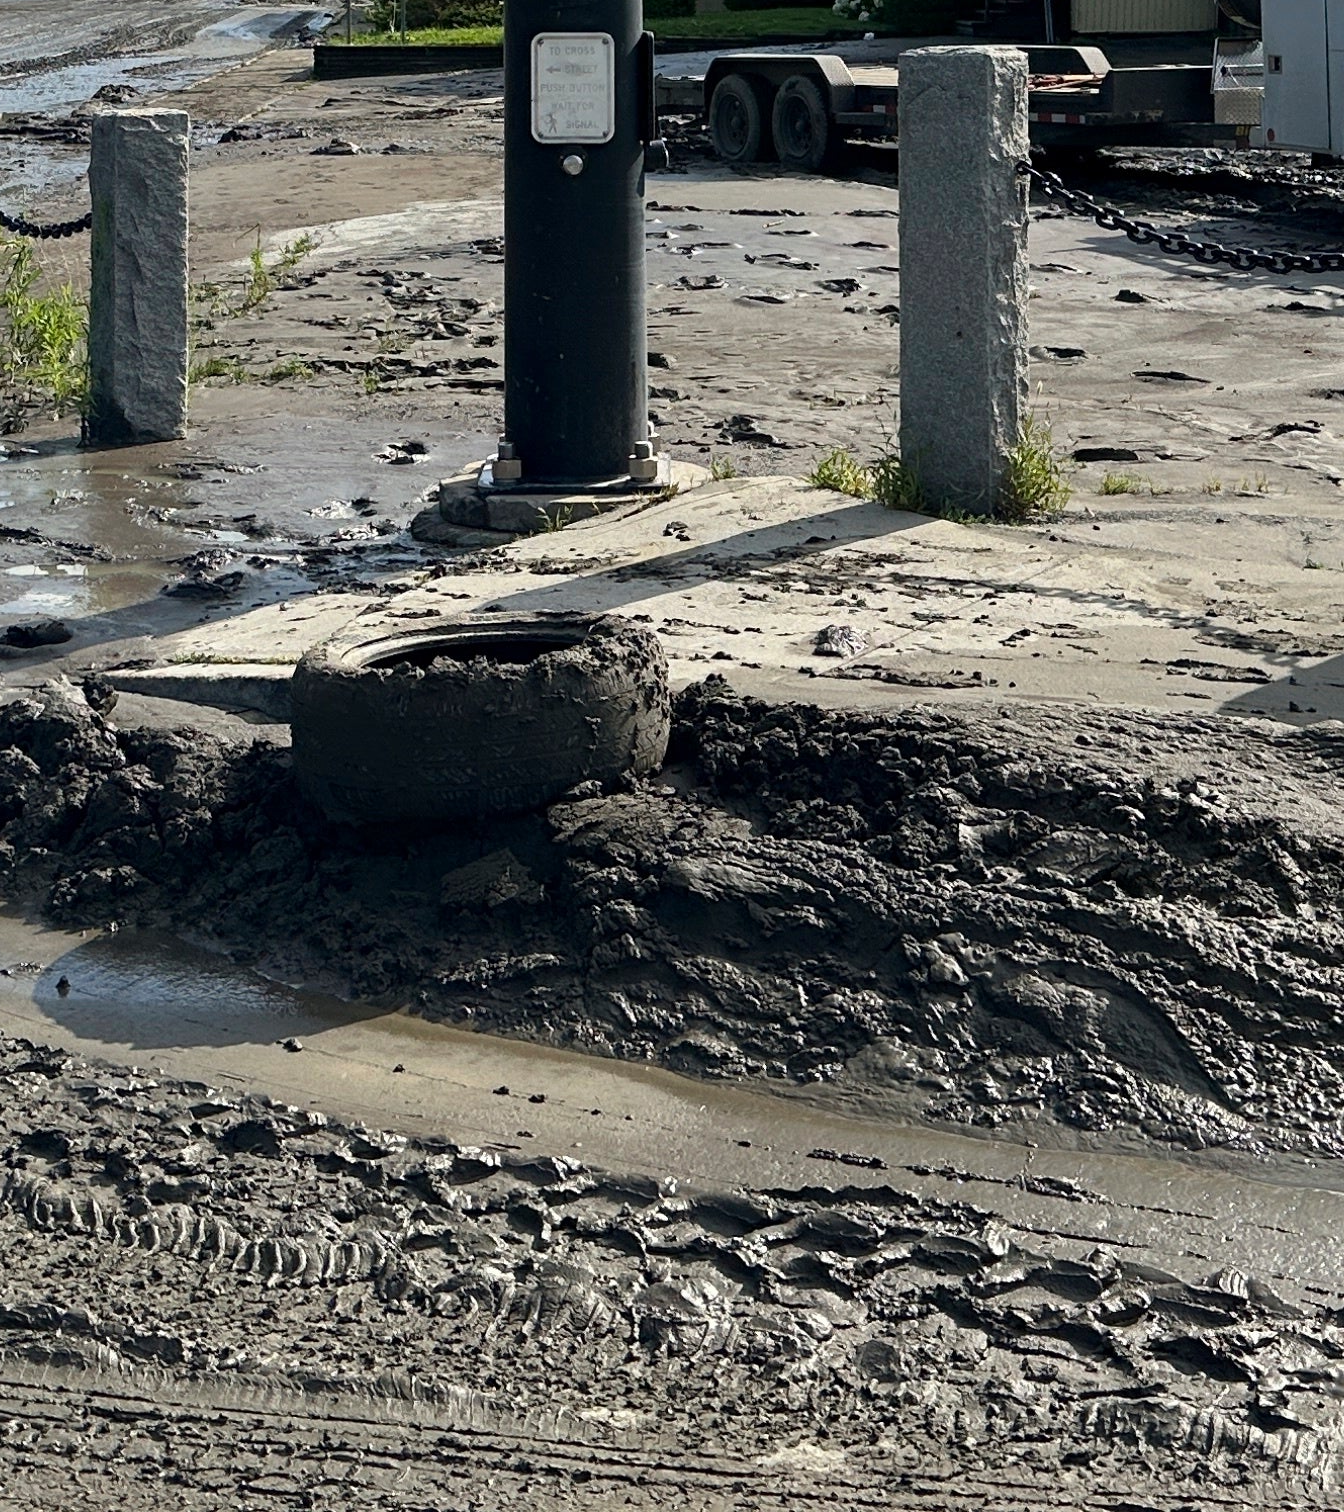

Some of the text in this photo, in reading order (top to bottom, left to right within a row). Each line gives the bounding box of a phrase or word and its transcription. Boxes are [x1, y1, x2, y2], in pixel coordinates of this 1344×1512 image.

[549, 46, 596, 56] TO CROSS
[564, 64, 598, 74] STREET
[540, 84, 605, 93] PUSH BUTTON
[566, 120, 600, 129] SIGNAL
